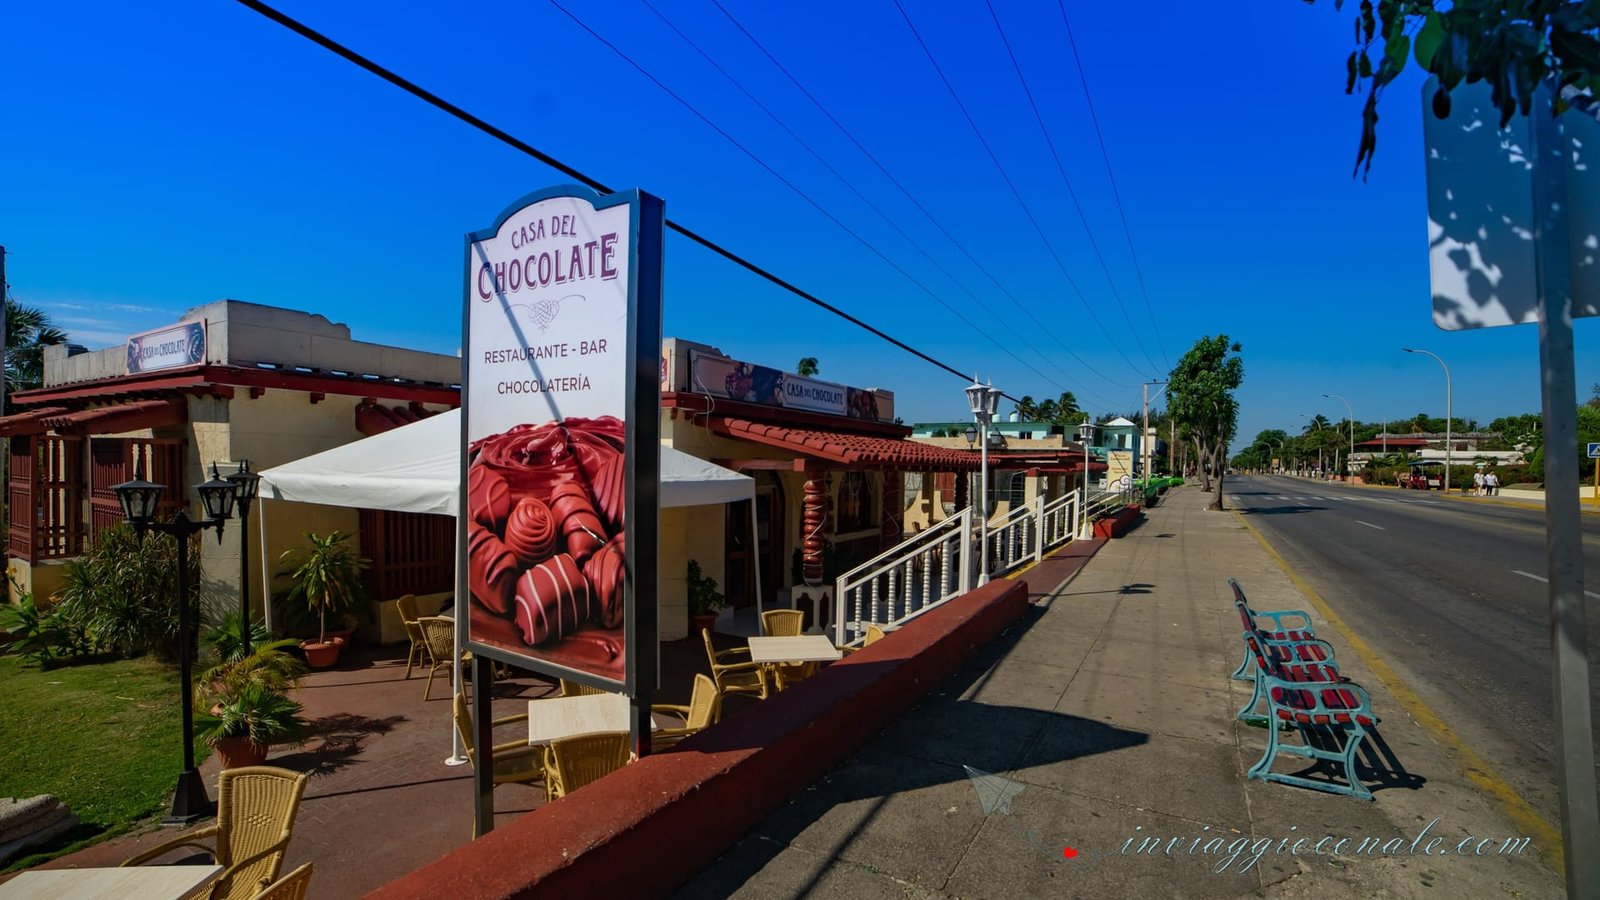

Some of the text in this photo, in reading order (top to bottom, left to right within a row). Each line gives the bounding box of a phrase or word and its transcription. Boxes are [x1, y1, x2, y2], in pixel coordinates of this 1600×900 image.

[511, 215, 577, 250] CASA DEL
[477, 232, 619, 303] CHOCOLATE
[159, 339, 185, 356] CHOCOLATE
[484, 343, 568, 364] RESTAURANTE
[580, 339, 608, 356] BAR
[497, 373, 591, 395] CHOCOLATERÍA
[787, 383, 804, 398] CASA
[812, 388, 844, 405] CHOCOLATE
